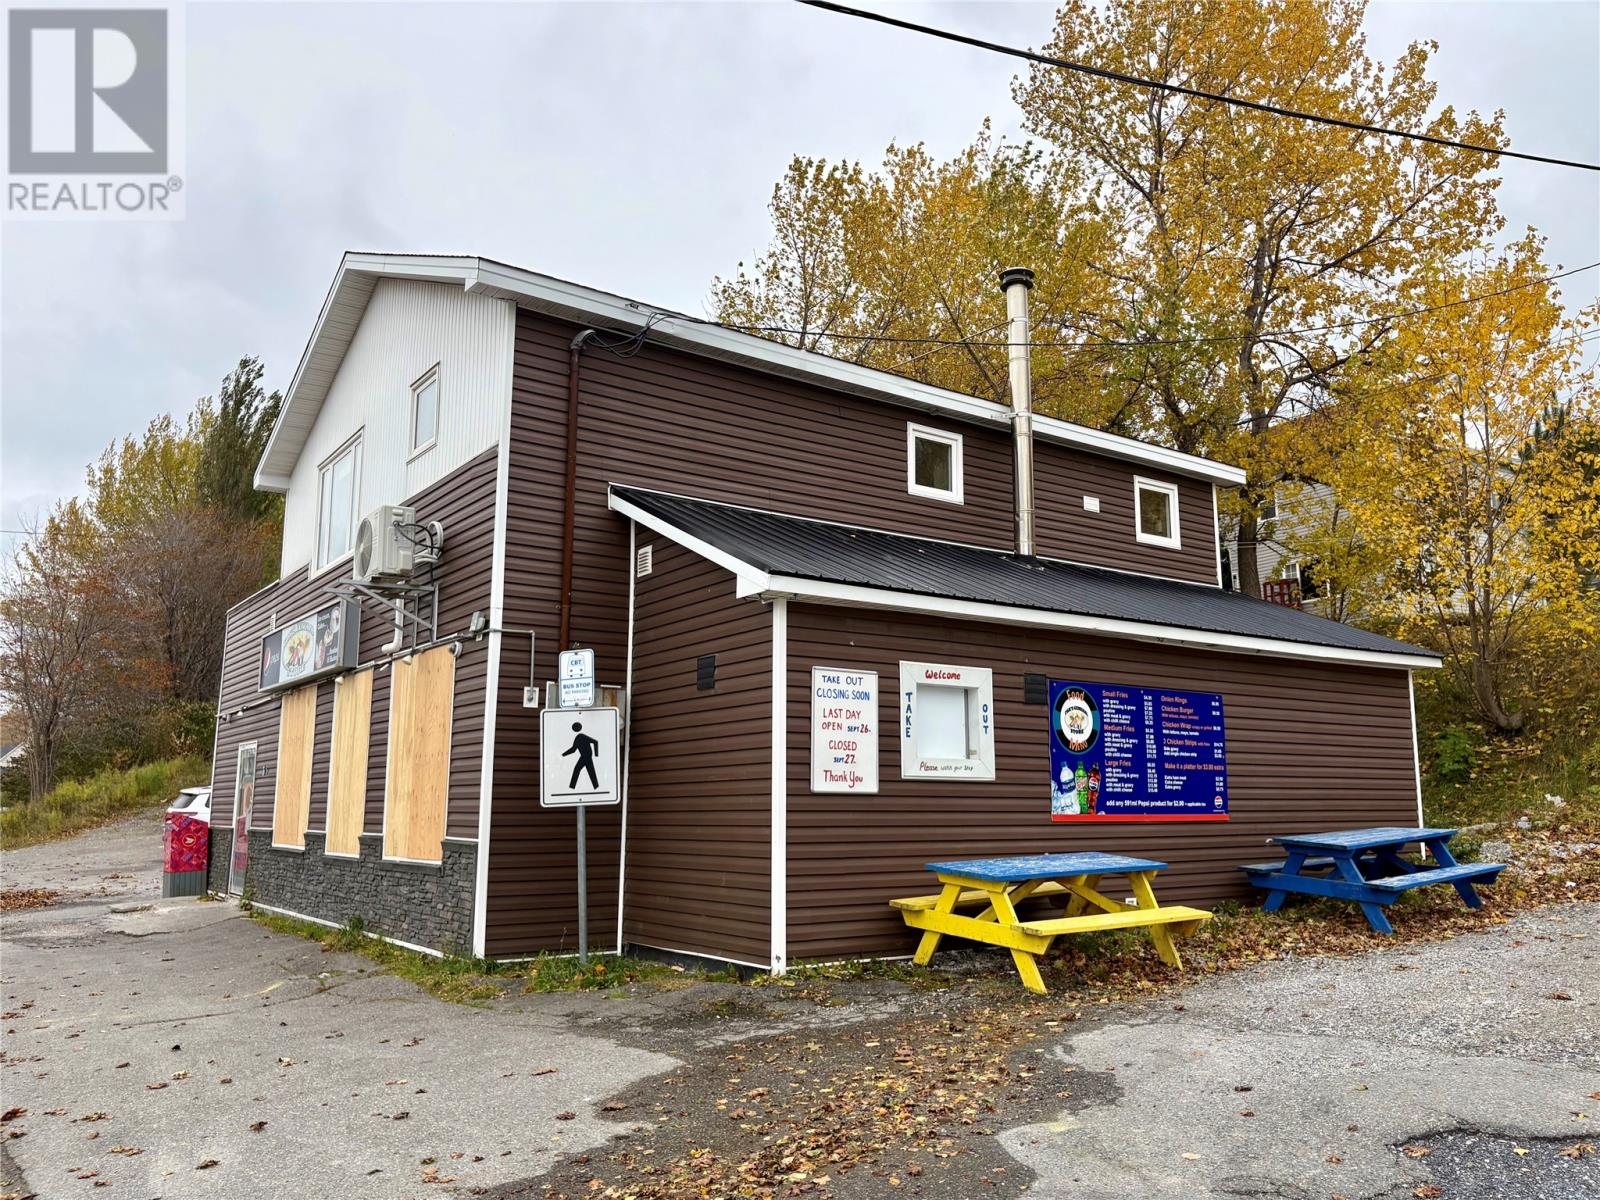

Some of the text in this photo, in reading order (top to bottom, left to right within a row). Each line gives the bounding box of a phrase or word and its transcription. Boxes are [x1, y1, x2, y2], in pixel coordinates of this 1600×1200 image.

[925, 669, 960, 680] Welcome
[822, 675, 863, 686] TAKE OUT
[816, 688, 870, 701] CLOSING SOON
[1066, 689, 1085, 700] Food
[1175, 696, 1188, 704] Rings
[823, 708, 861, 720] LAST DAY
[905, 692, 913, 738] TAKE
[1179, 706, 1194, 714] Burger
[821, 722, 843, 731] OPEN
[828, 740, 857, 751] CLOSED
[1185, 739, 1197, 747] Strips
[920, 761, 938, 771] Please
[823, 770, 863, 788] Thank You
